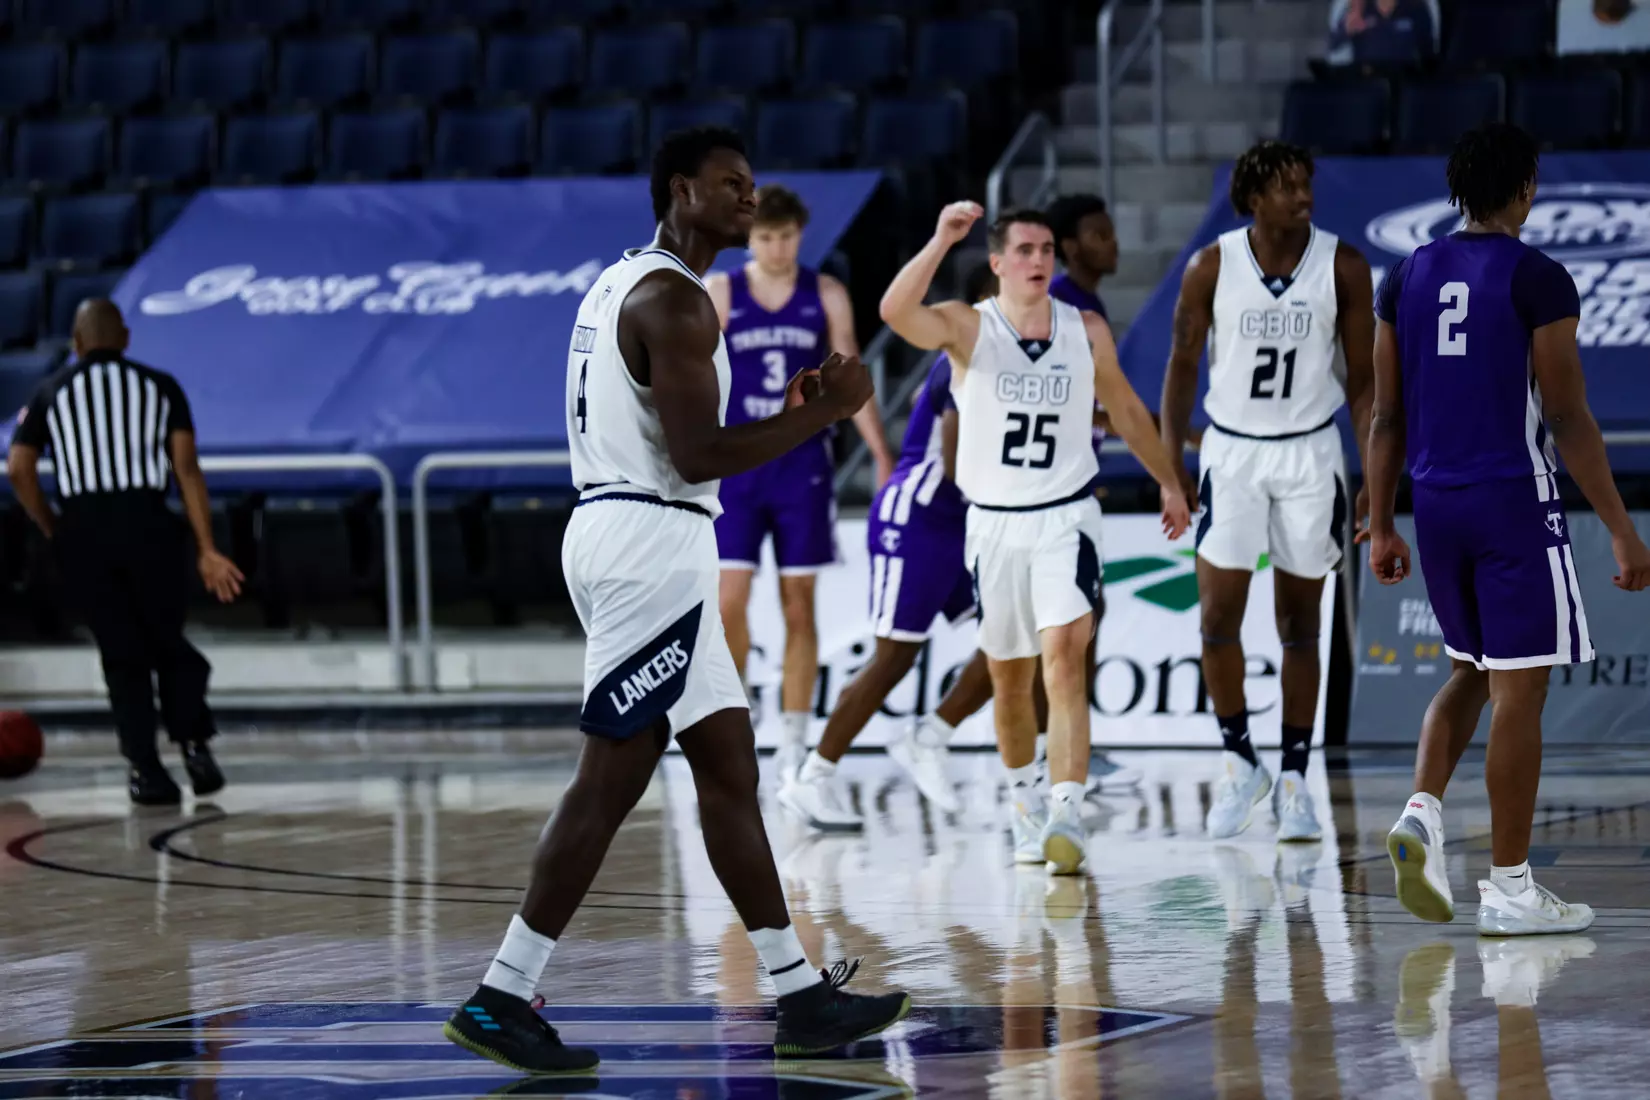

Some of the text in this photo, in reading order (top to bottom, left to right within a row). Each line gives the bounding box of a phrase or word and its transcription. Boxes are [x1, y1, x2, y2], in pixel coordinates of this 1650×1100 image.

[1240, 309, 1312, 340] CBU
[1437, 281, 1470, 355] 2
[576, 358, 588, 434] 4
[762, 350, 786, 392] 3
[997, 372, 1071, 406] CBU
[1249, 346, 1297, 399] 21
[1001, 411, 1059, 468] 25
[609, 639, 689, 716] LANCERS
